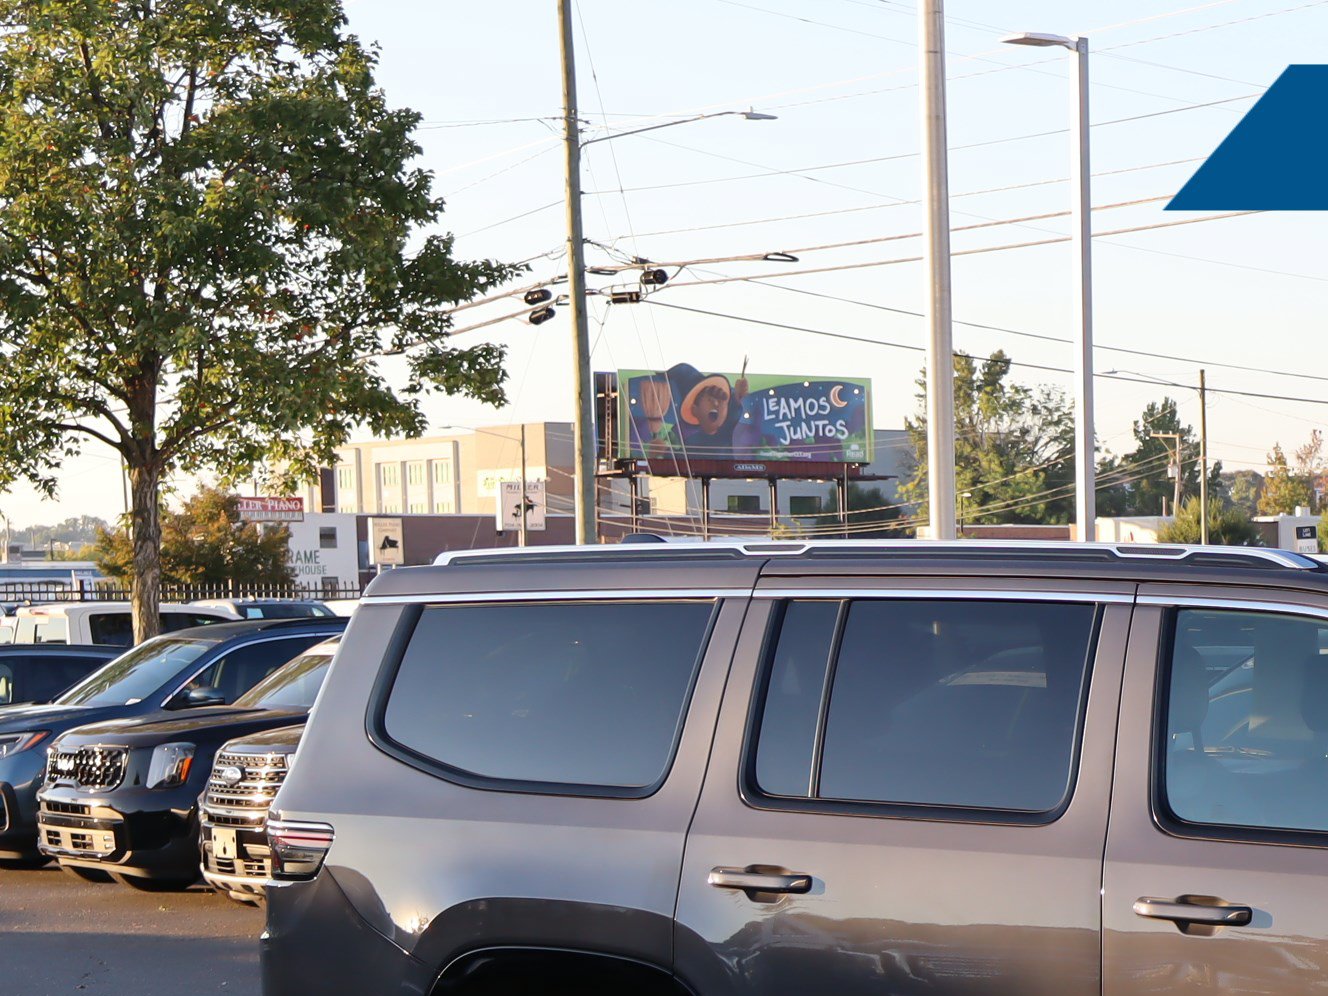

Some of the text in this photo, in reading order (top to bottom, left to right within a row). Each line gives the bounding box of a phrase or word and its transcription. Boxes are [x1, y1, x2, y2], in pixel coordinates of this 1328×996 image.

[763, 397, 831, 421] LEAMOS
[775, 420, 849, 446] JUNTOS
[268, 499, 300, 511] PIANO
[286, 550, 320, 564] RAME
